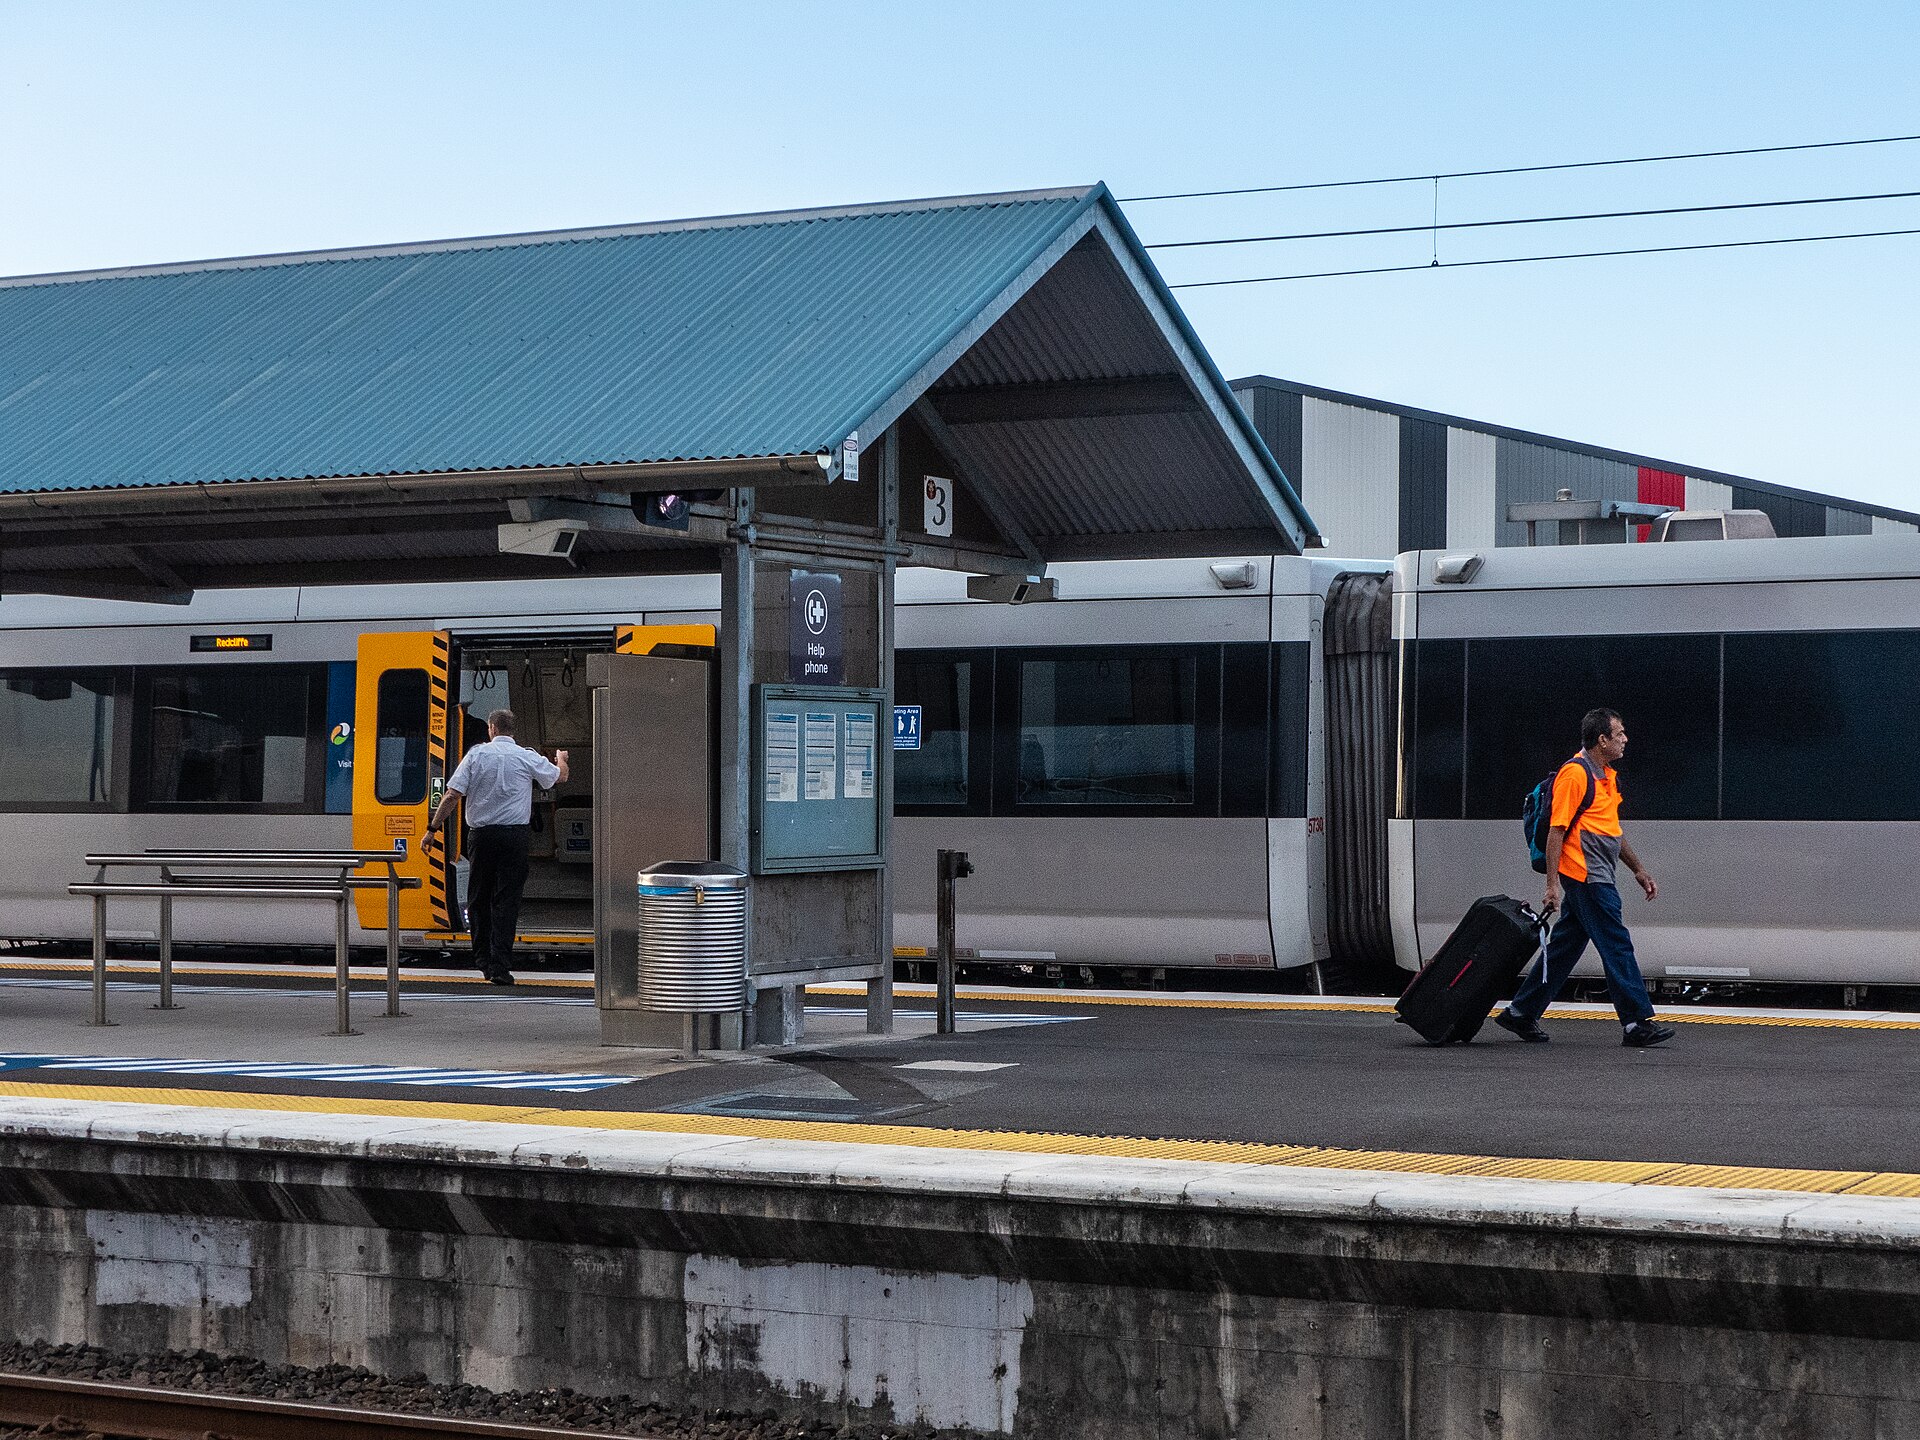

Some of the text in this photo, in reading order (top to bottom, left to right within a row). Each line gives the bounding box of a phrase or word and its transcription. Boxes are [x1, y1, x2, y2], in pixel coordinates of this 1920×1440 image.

[932, 486, 946, 526] 3
[216, 637, 249, 647] Redcliffe
[807, 642, 825, 659] Help
[804, 660, 829, 676] phone
[337, 760, 352, 768] Visit
[1308, 816, 1324, 834] 5730
